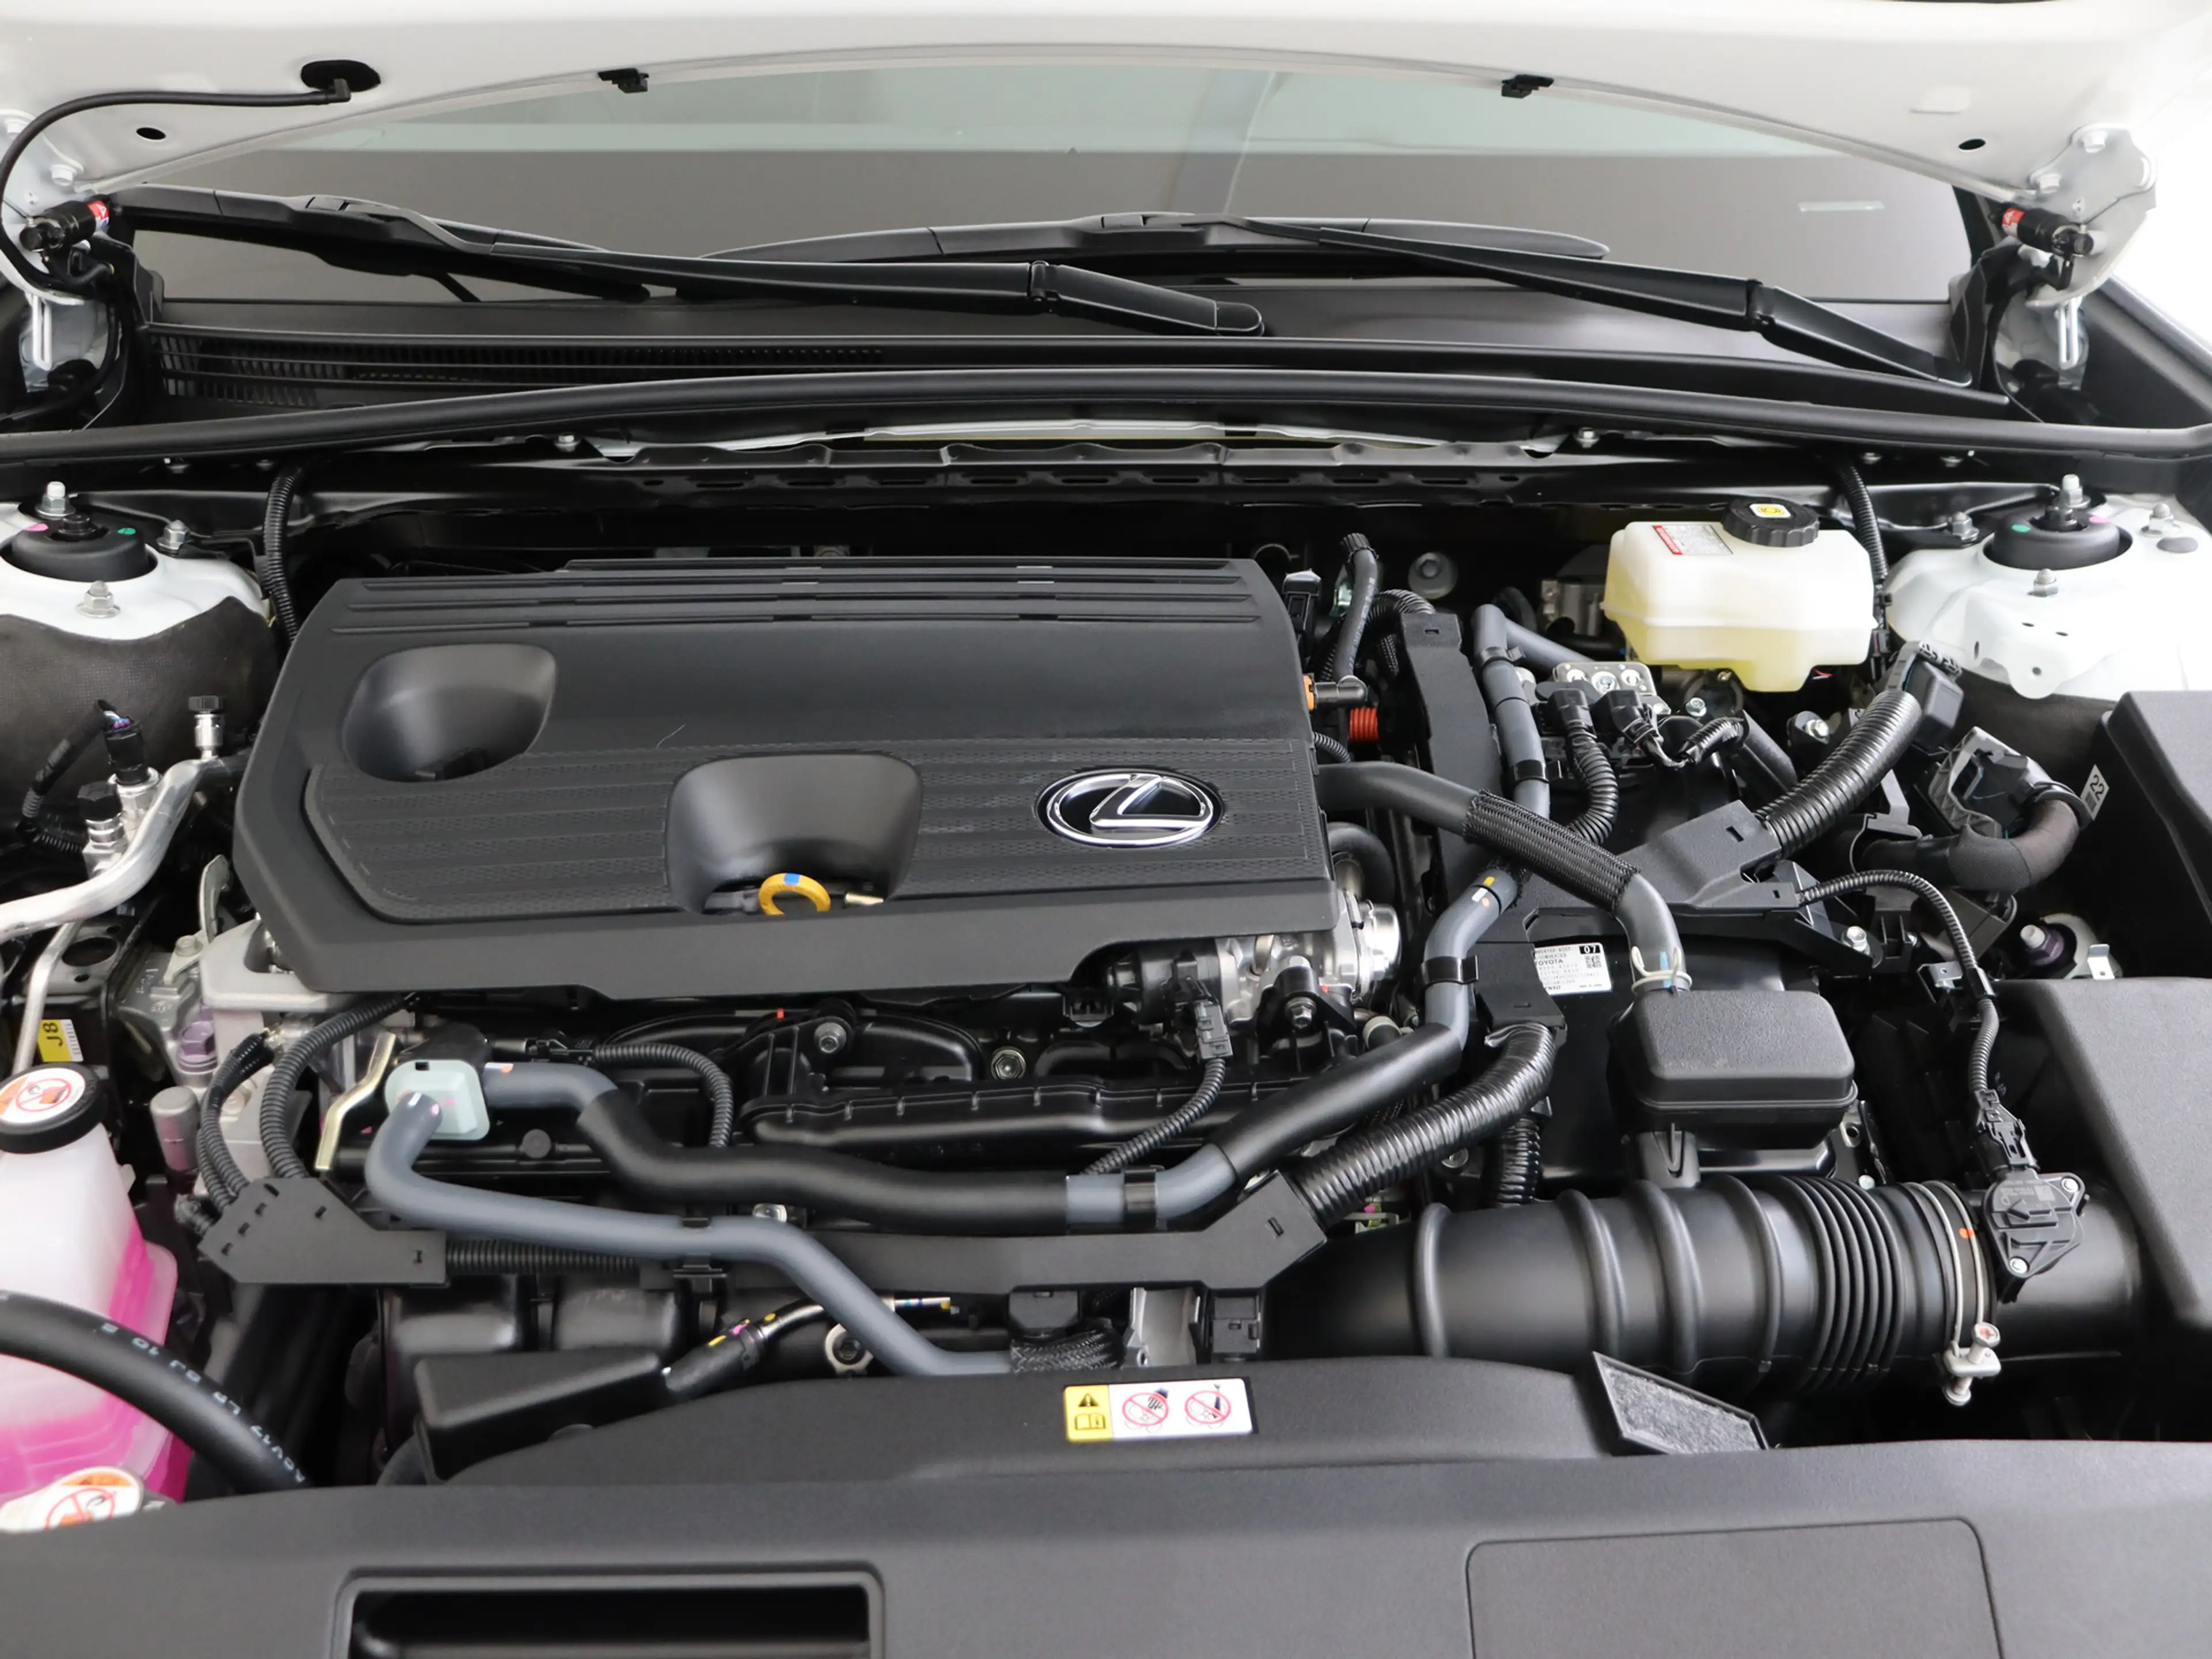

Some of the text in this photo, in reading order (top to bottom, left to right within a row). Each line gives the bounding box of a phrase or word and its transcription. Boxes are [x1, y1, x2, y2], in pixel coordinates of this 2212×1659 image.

[2090, 774, 2104, 801] 22
[1584, 945, 1596, 954] 07
[43, 1022, 63, 1047] J8
